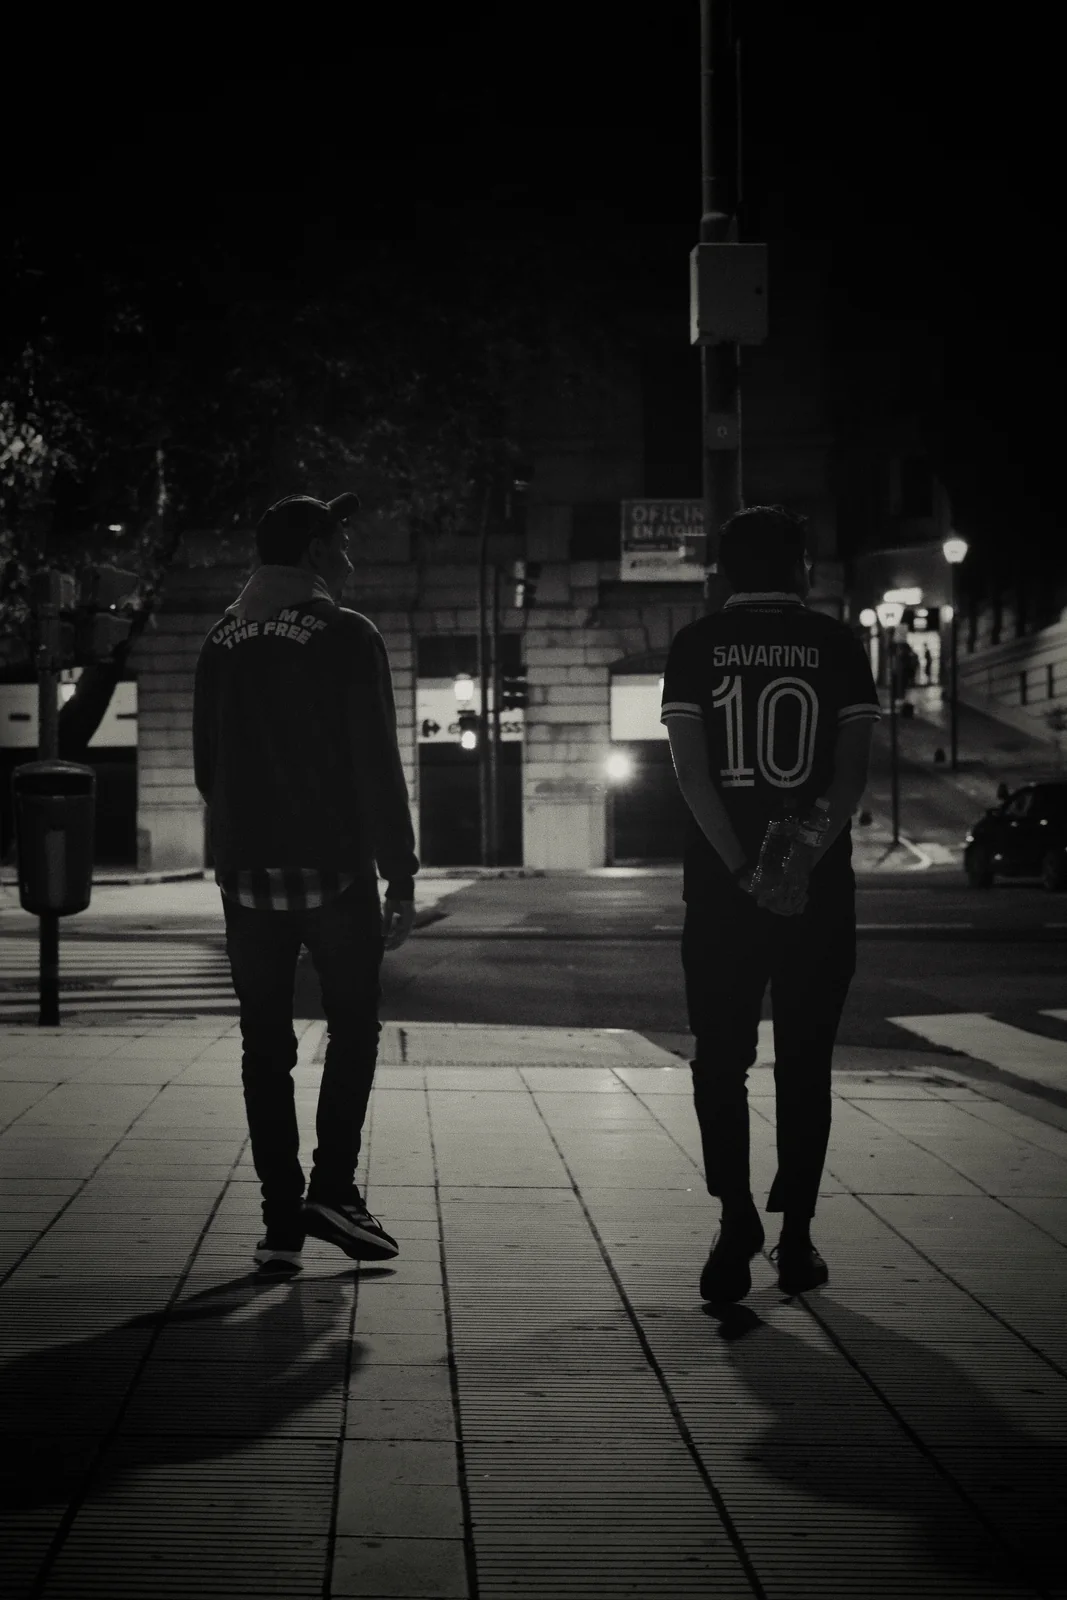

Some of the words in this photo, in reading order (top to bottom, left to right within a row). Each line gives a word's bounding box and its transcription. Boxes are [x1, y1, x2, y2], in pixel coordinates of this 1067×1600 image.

[631, 504, 705, 523] OFICIN
[212, 609, 300, 644] UNIM
[301, 614, 328, 630] OF
[222, 622, 259, 650] THE
[263, 621, 312, 645] FREE
[713, 645, 819, 668] SAVARINO
[712, 675, 819, 788] 10
